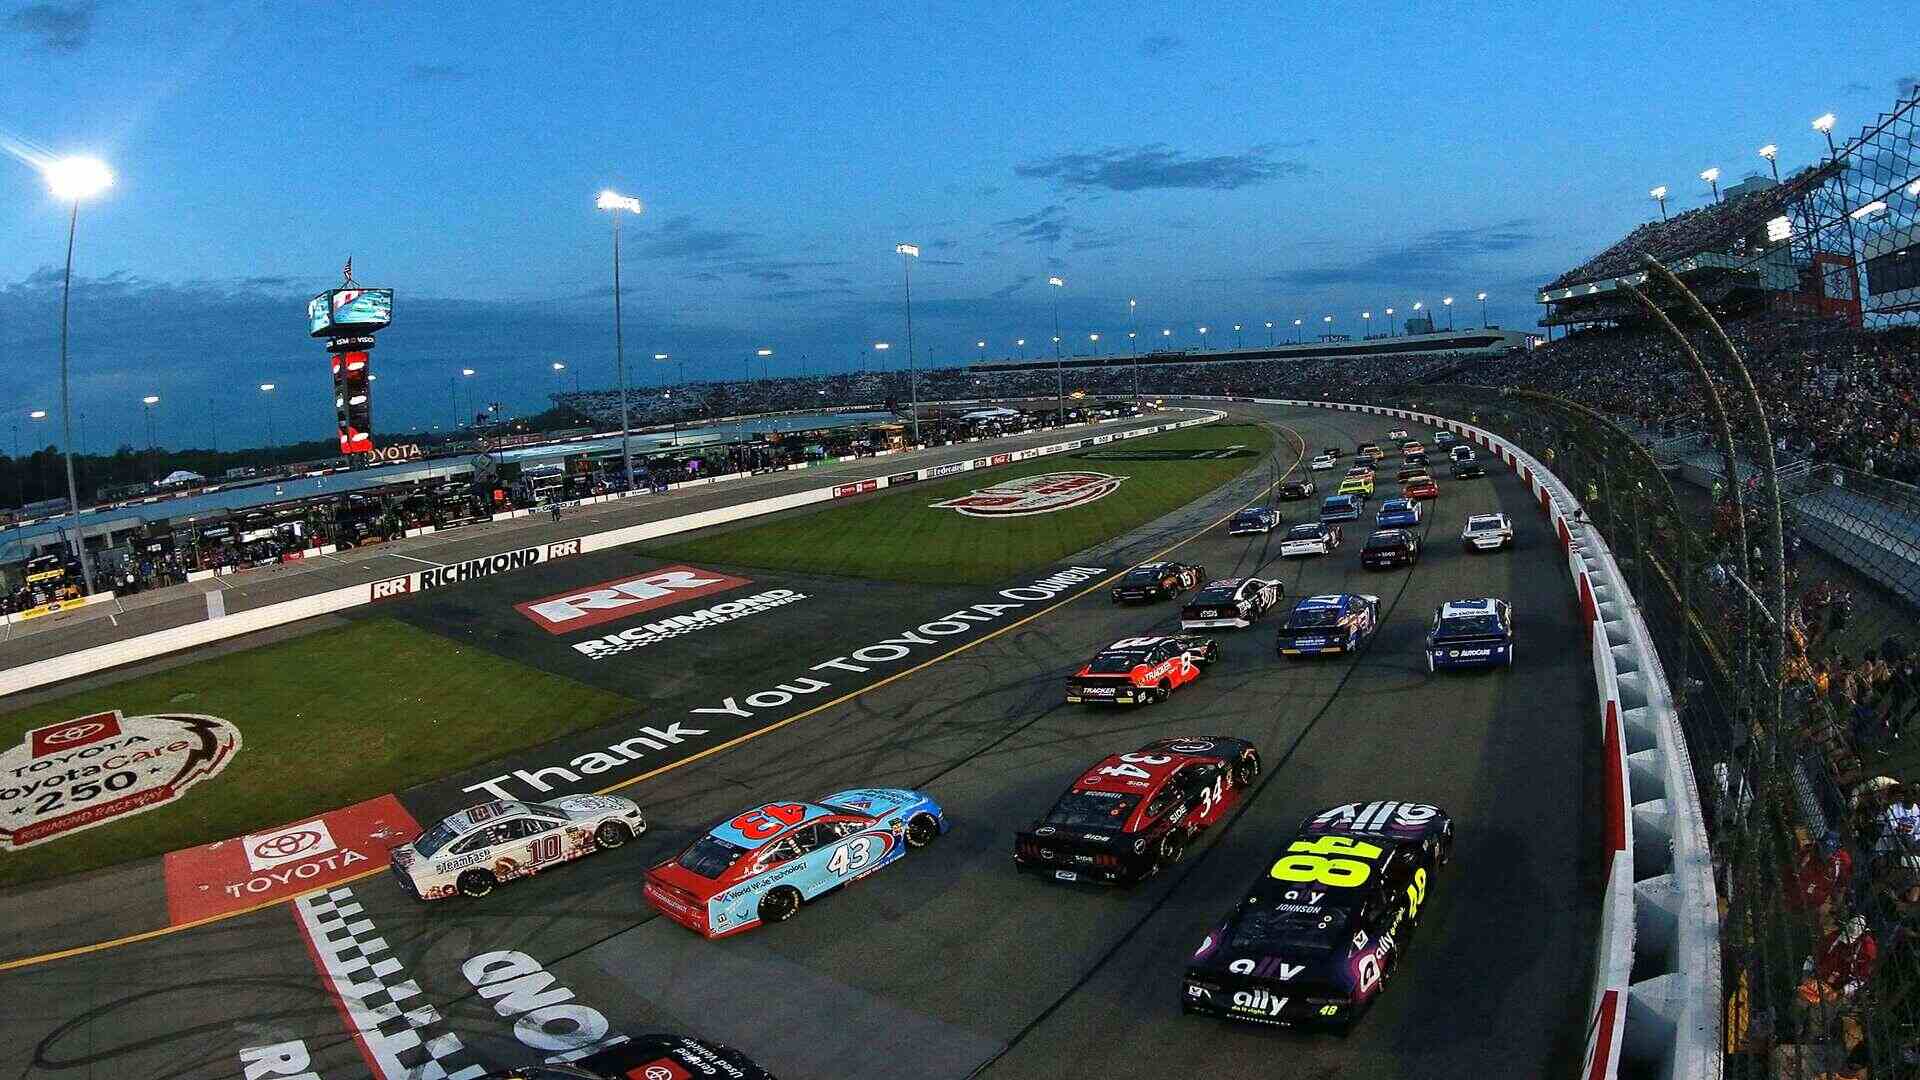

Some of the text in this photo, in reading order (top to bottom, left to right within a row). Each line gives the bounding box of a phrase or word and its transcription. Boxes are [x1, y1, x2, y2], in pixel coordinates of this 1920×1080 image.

[374, 540, 579, 599] RR RICHMOND RR
[528, 570, 726, 623] RR
[714, 593, 809, 624] RACEWAY
[571, 588, 794, 655] RICHMOND
[462, 720, 708, 802] Thank
[690, 676, 830, 720] You
[816, 602, 1025, 673] TOYOTA
[1083, 687, 1116, 696] TRACKER
[0, 740, 190, 801] oyotaCare
[9, 735, 150, 778] TOYOTA
[1100, 752, 1172, 779] 34
[35, 770, 137, 816] 250
[1200, 775, 1223, 818] 34
[731, 803, 807, 840] 43
[1170, 805, 1189, 824] SIDE
[1312, 800, 1440, 831] ally
[527, 834, 562, 866] 10
[826, 837, 871, 878] 43
[1270, 836, 1383, 888] 48
[226, 847, 369, 899] TOYOTA
[729, 886, 751, 899] World
[1275, 903, 1321, 914] JOHNSON
[1233, 989, 1289, 1016] ally
[1320, 1005, 1338, 1016] 48
[713, 1059, 744, 1079] Used
